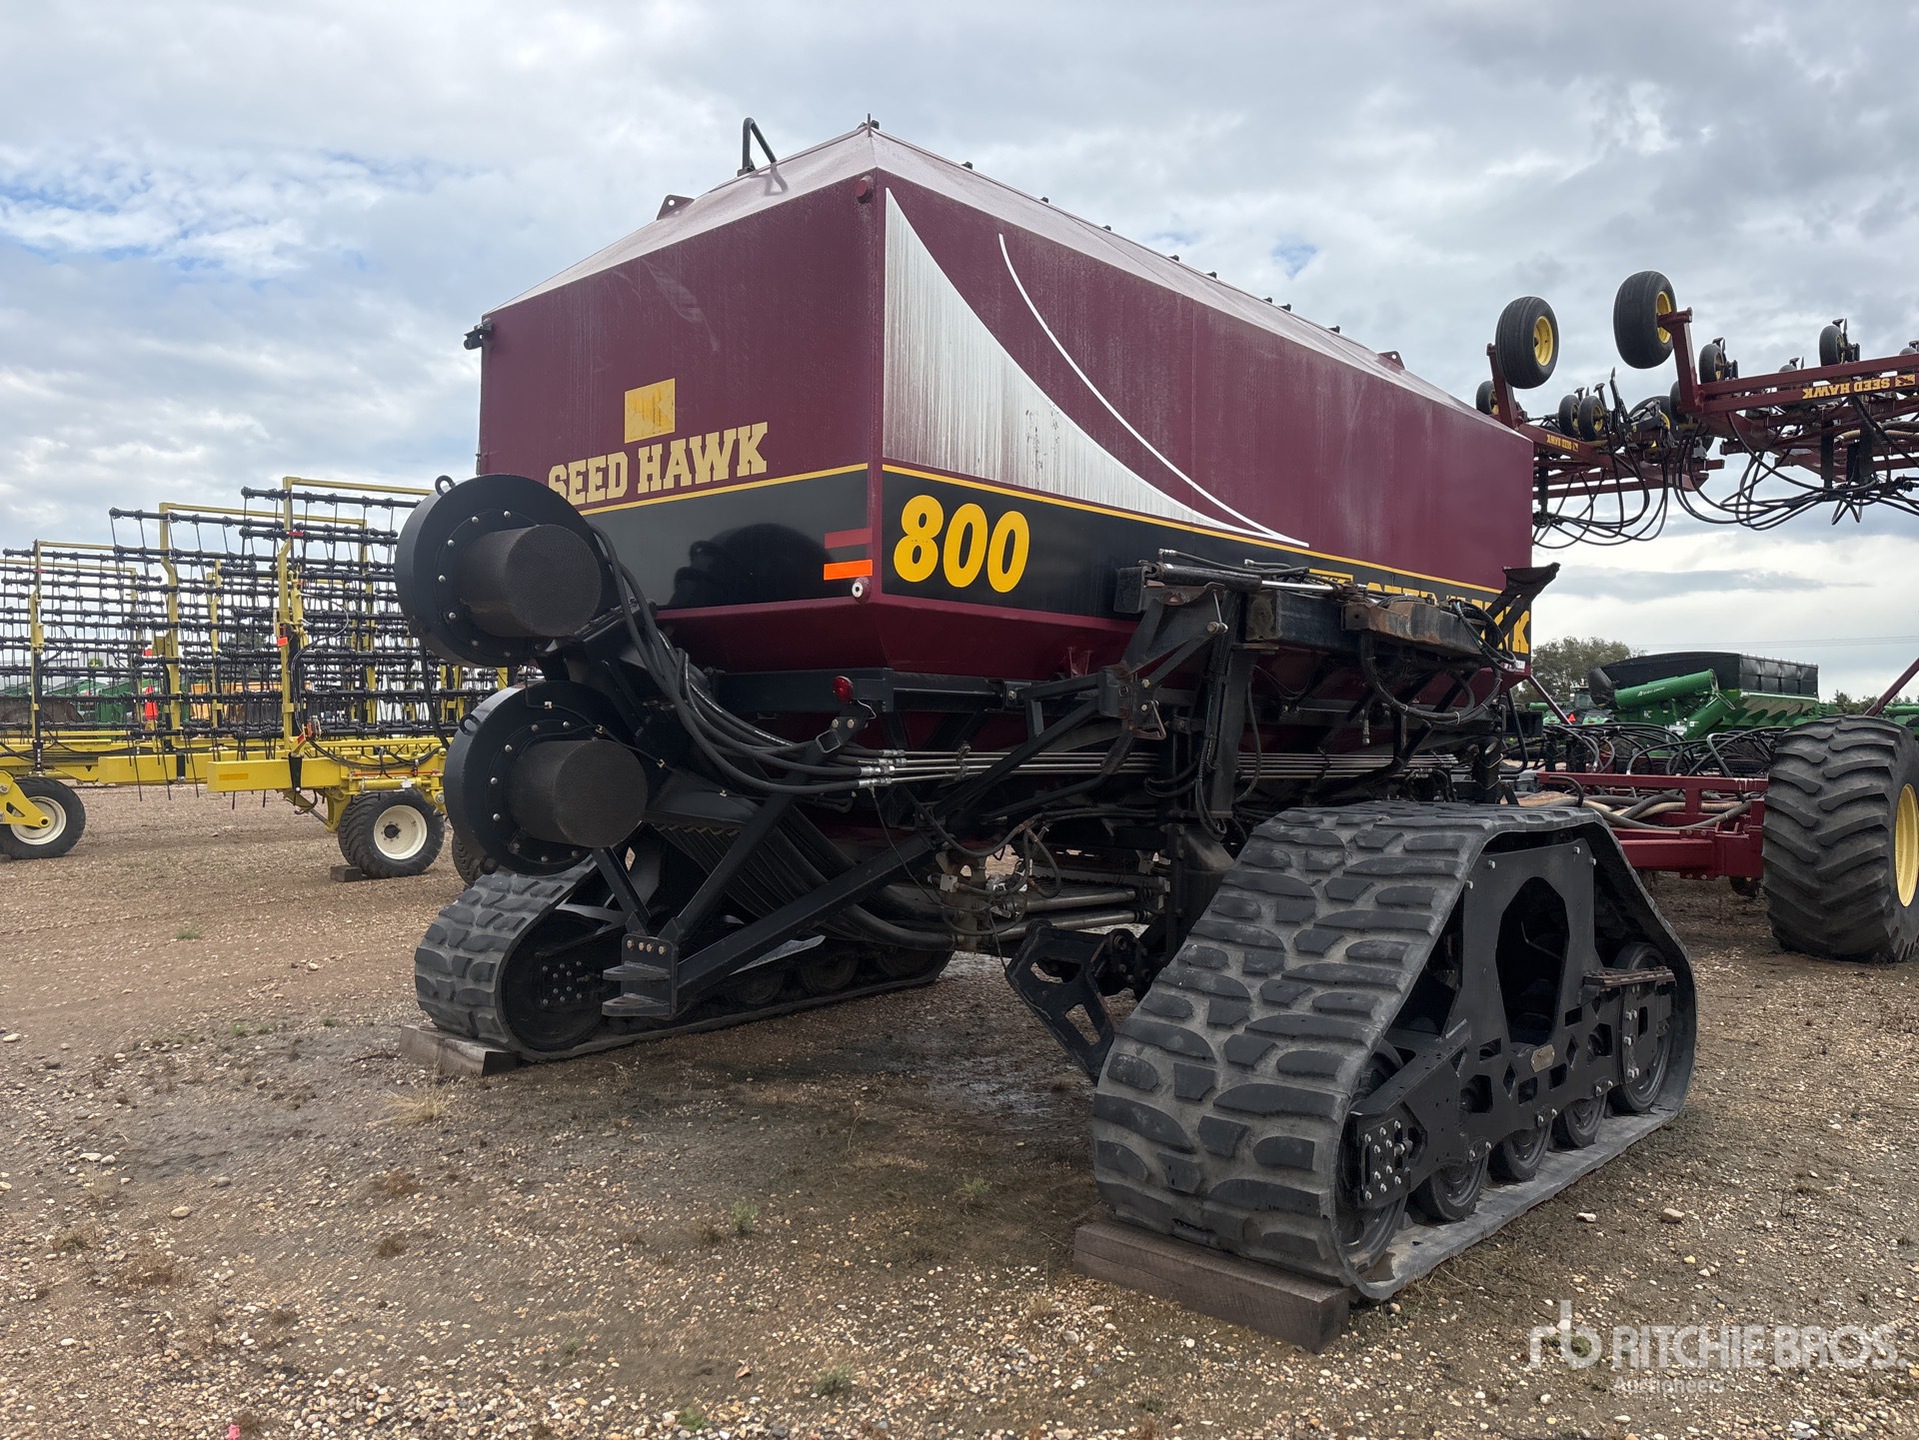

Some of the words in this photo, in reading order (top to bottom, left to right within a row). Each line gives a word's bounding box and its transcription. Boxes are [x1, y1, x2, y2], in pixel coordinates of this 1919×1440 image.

[1802, 382, 1851, 399] HAWK
[1853, 378, 1891, 393] SEED
[548, 451, 628, 506] SEED
[637, 421, 768, 494] HAWK
[893, 494, 1030, 593] 800
